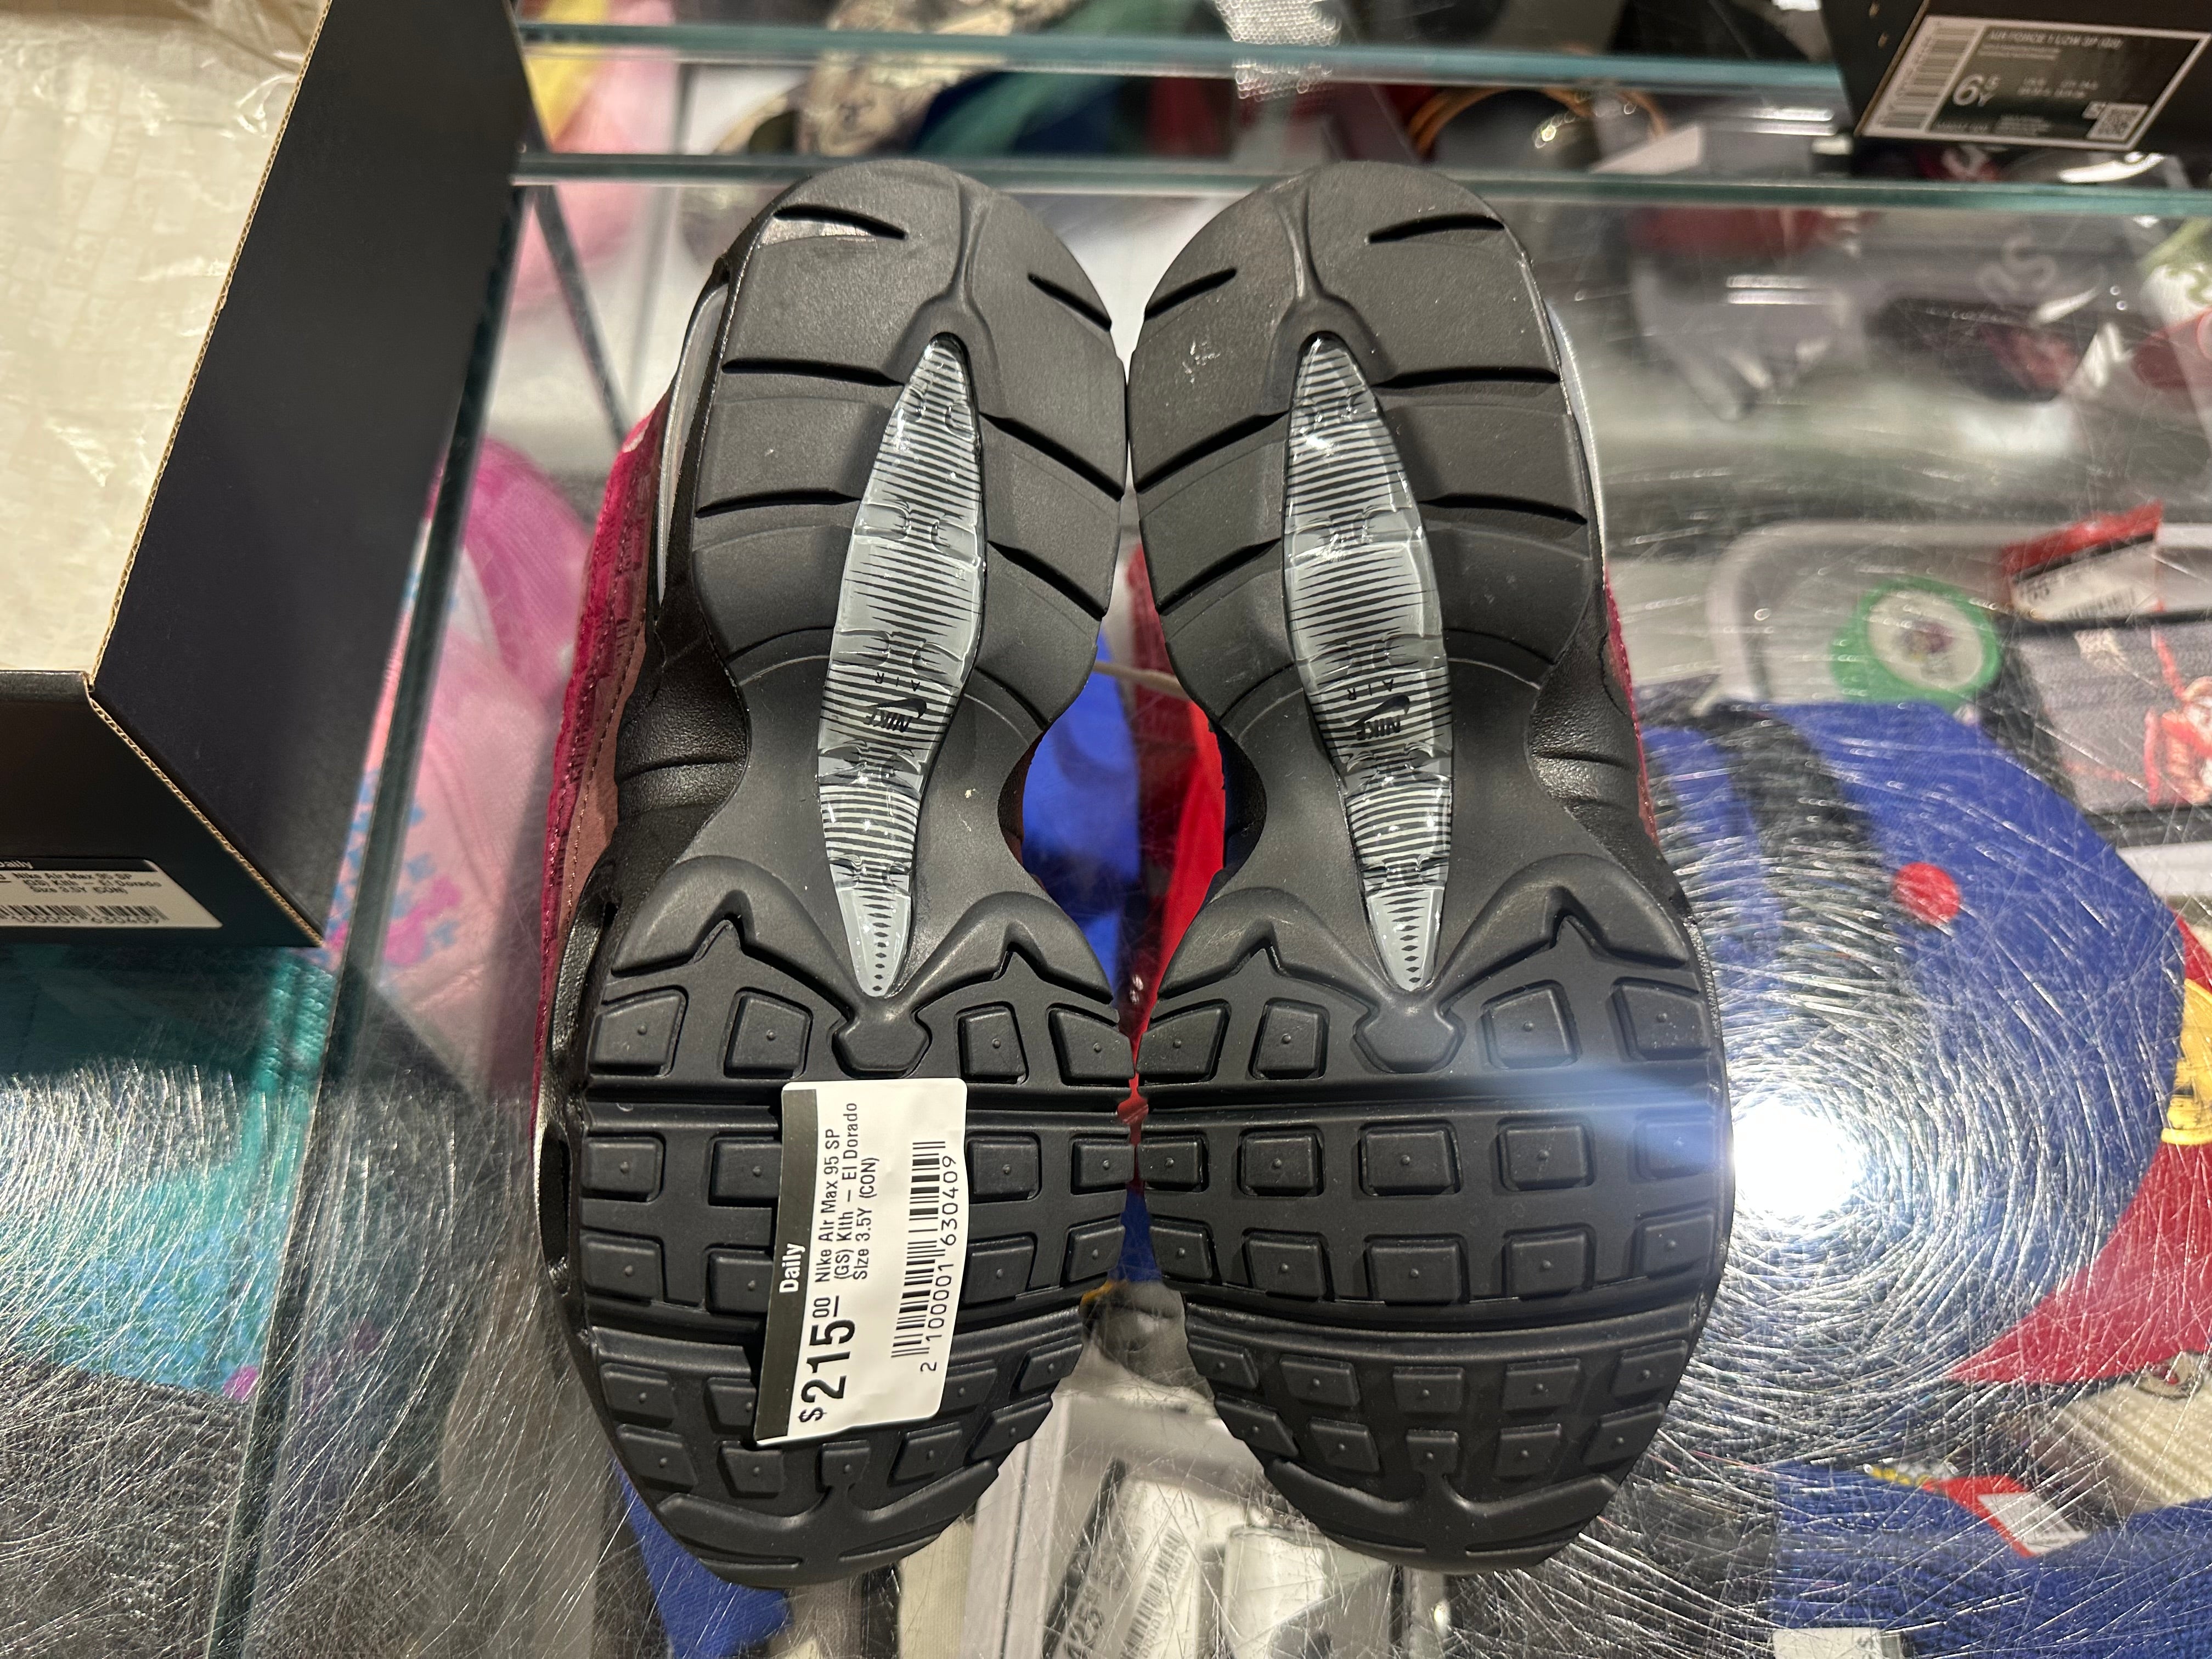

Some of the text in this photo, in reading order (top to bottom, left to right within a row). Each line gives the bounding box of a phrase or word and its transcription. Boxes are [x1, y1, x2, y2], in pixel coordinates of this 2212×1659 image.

[1953, 73, 1984, 106] 6
[875, 672, 921, 692] AIR
[1347, 679, 1393, 701] AIR
[843, 1102, 858, 1159] Dorado
[842, 1166, 857, 1180] El
[815, 1128, 840, 1283] Nike Air Max 95 SP
[853, 1157, 880, 1280] Size 3.5Y (CON)
[836, 1211, 854, 1242] Kith
[779, 1243, 805, 1294] Daily
[834, 1249, 854, 1280] (GS)
